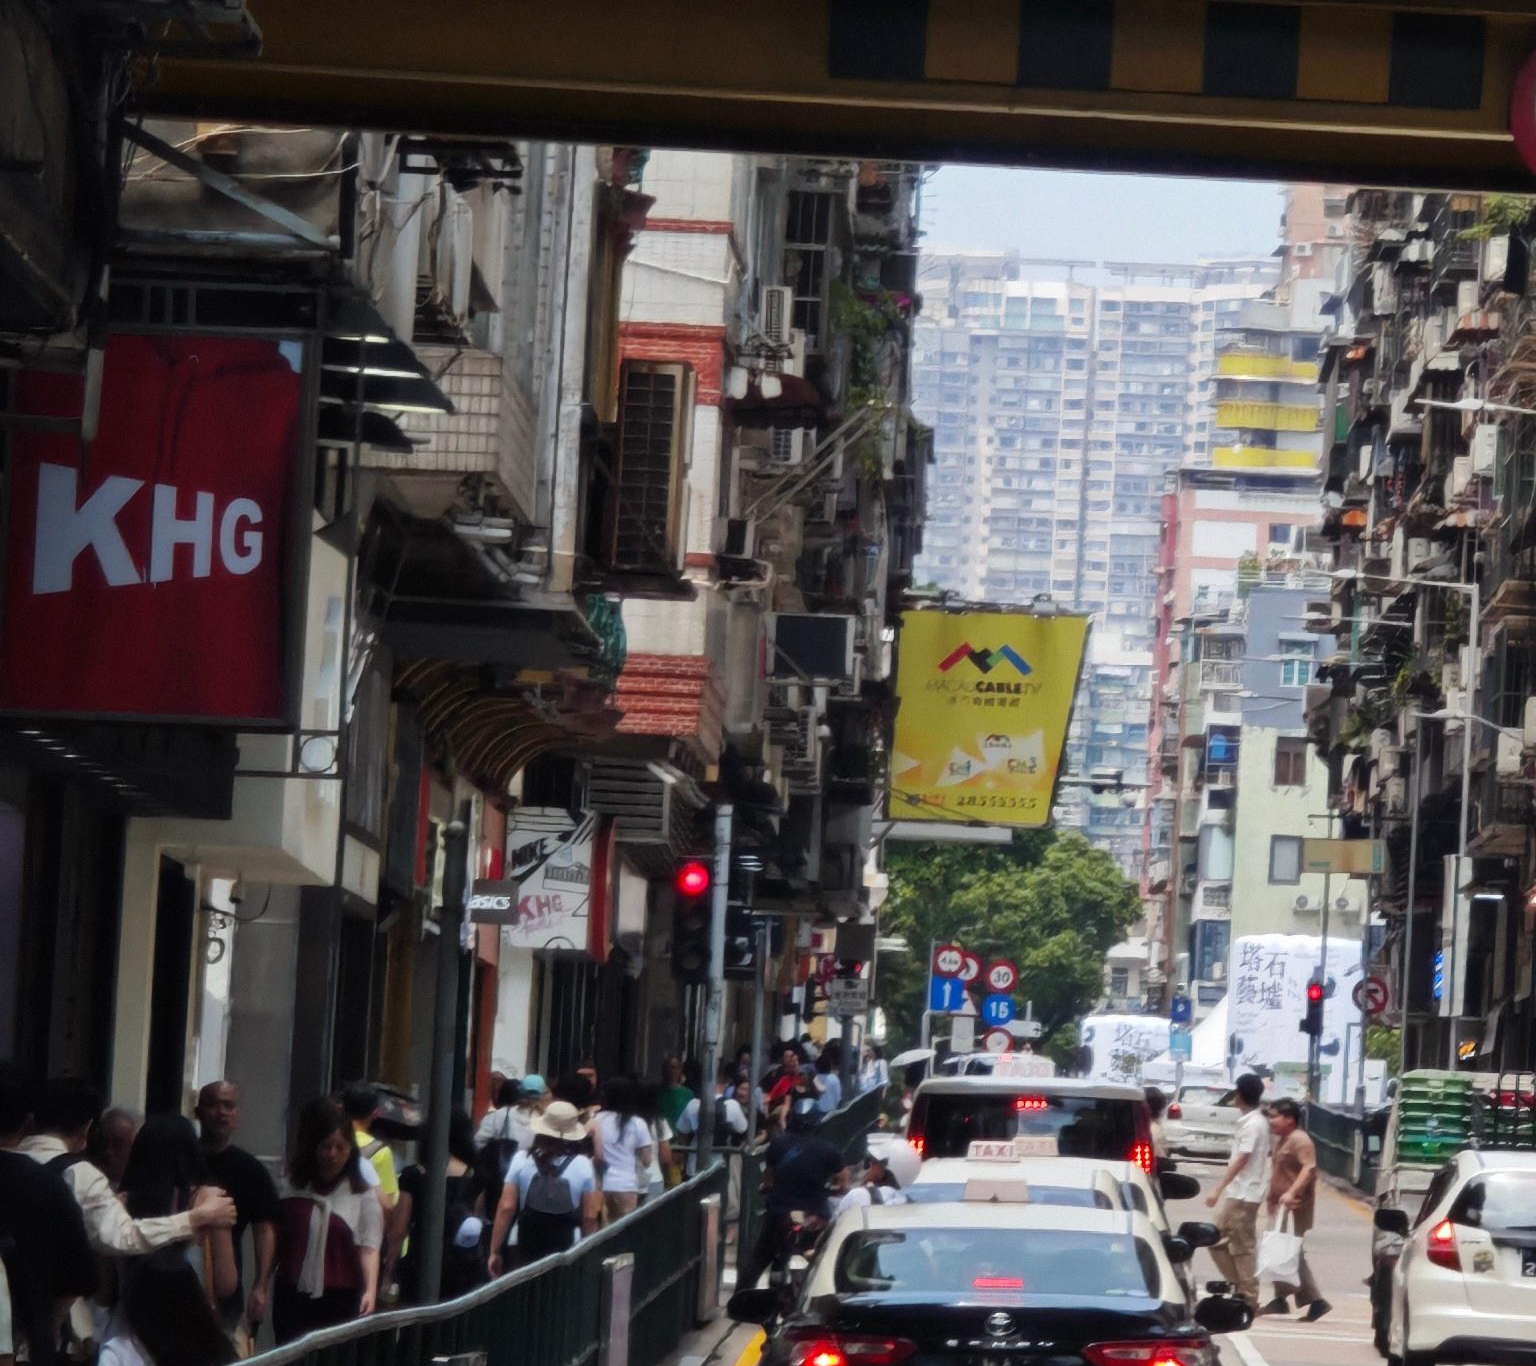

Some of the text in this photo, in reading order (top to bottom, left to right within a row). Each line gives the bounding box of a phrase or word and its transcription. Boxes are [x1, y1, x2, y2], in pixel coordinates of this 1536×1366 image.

[33, 463, 263, 594] KHG
[992, 971, 1011, 985] 30
[990, 1001, 1010, 1019] 15
